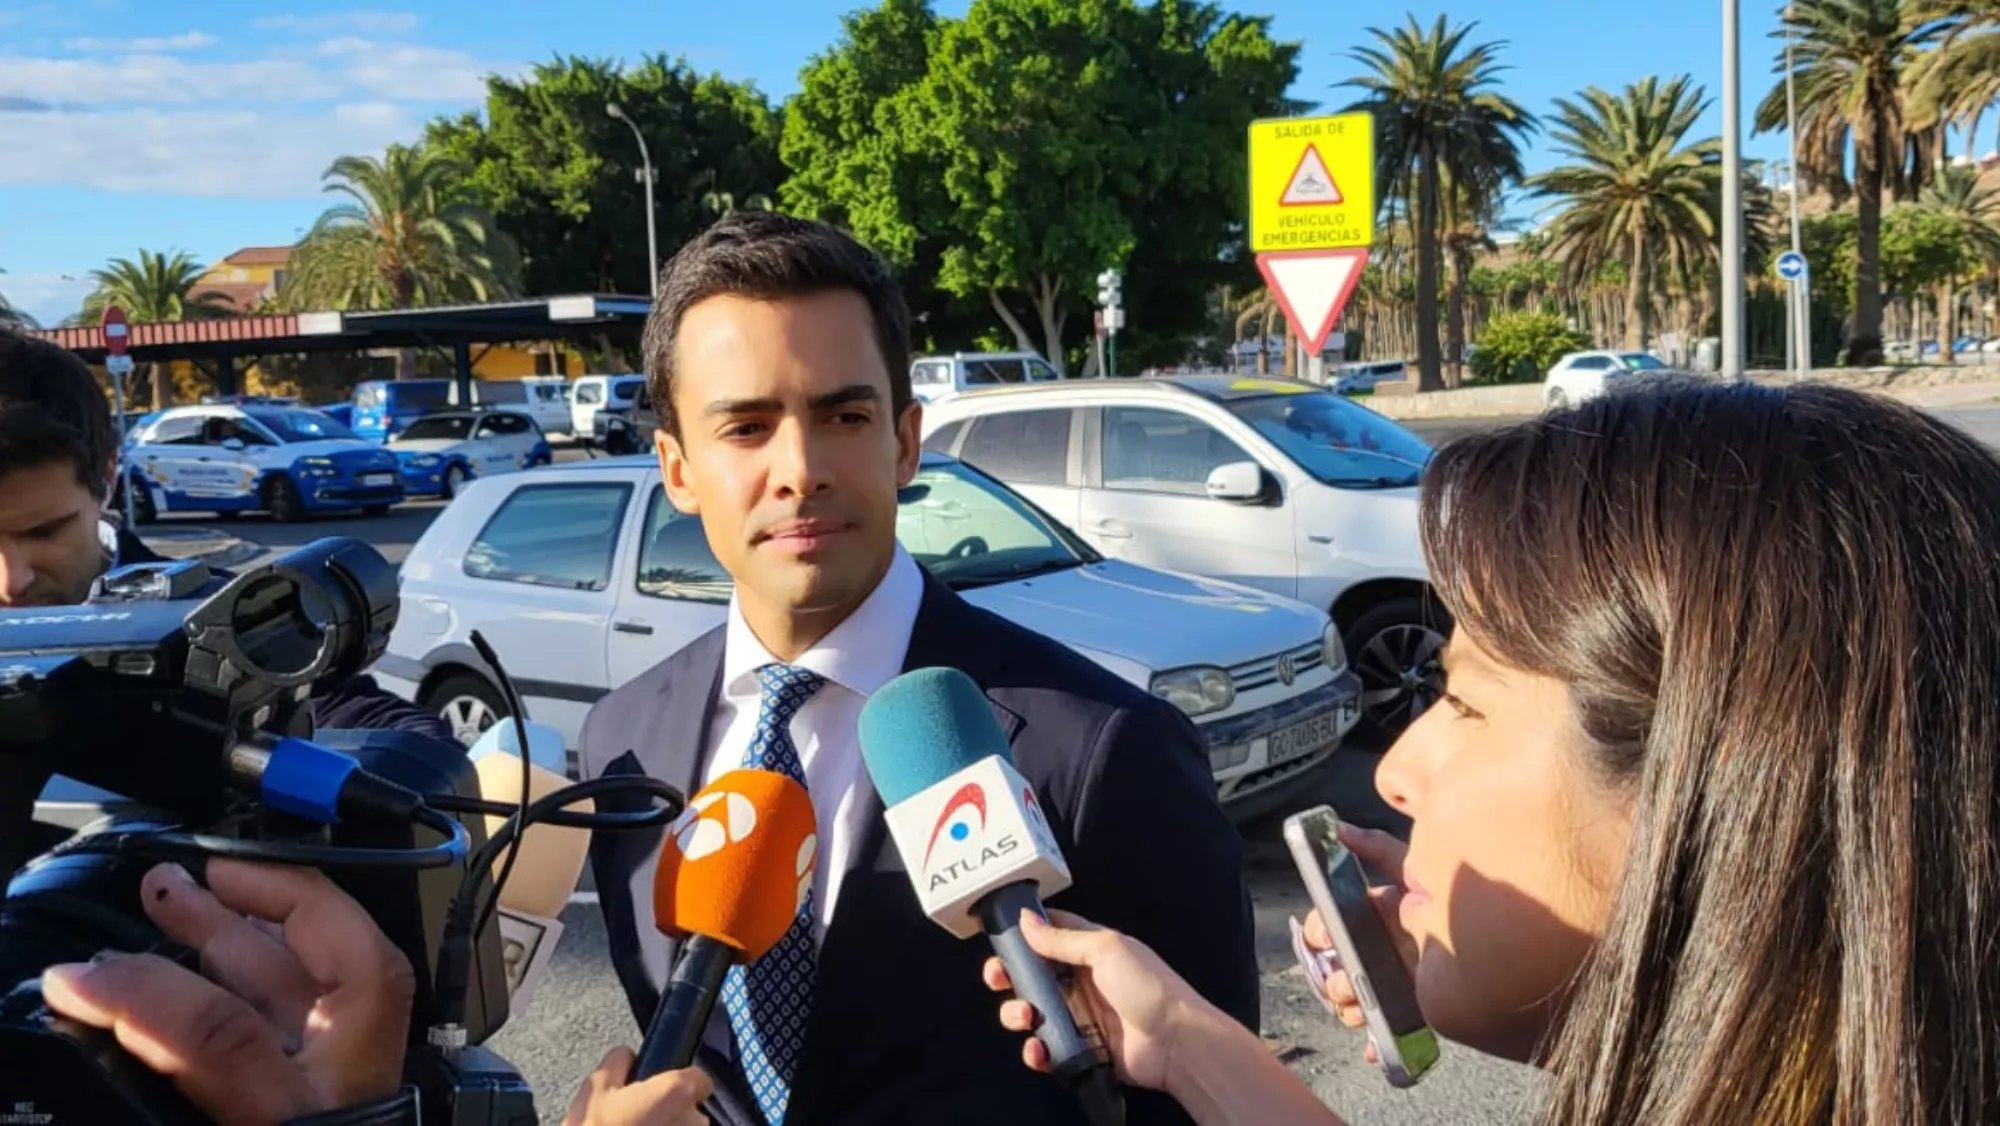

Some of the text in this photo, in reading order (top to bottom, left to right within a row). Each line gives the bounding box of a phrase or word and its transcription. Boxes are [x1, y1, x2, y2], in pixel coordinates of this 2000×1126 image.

[1275, 121, 1345, 140] SALIDA DE
[1263, 229, 1361, 246] EMERGENCIAS
[929, 833, 1019, 892] ATLAS
